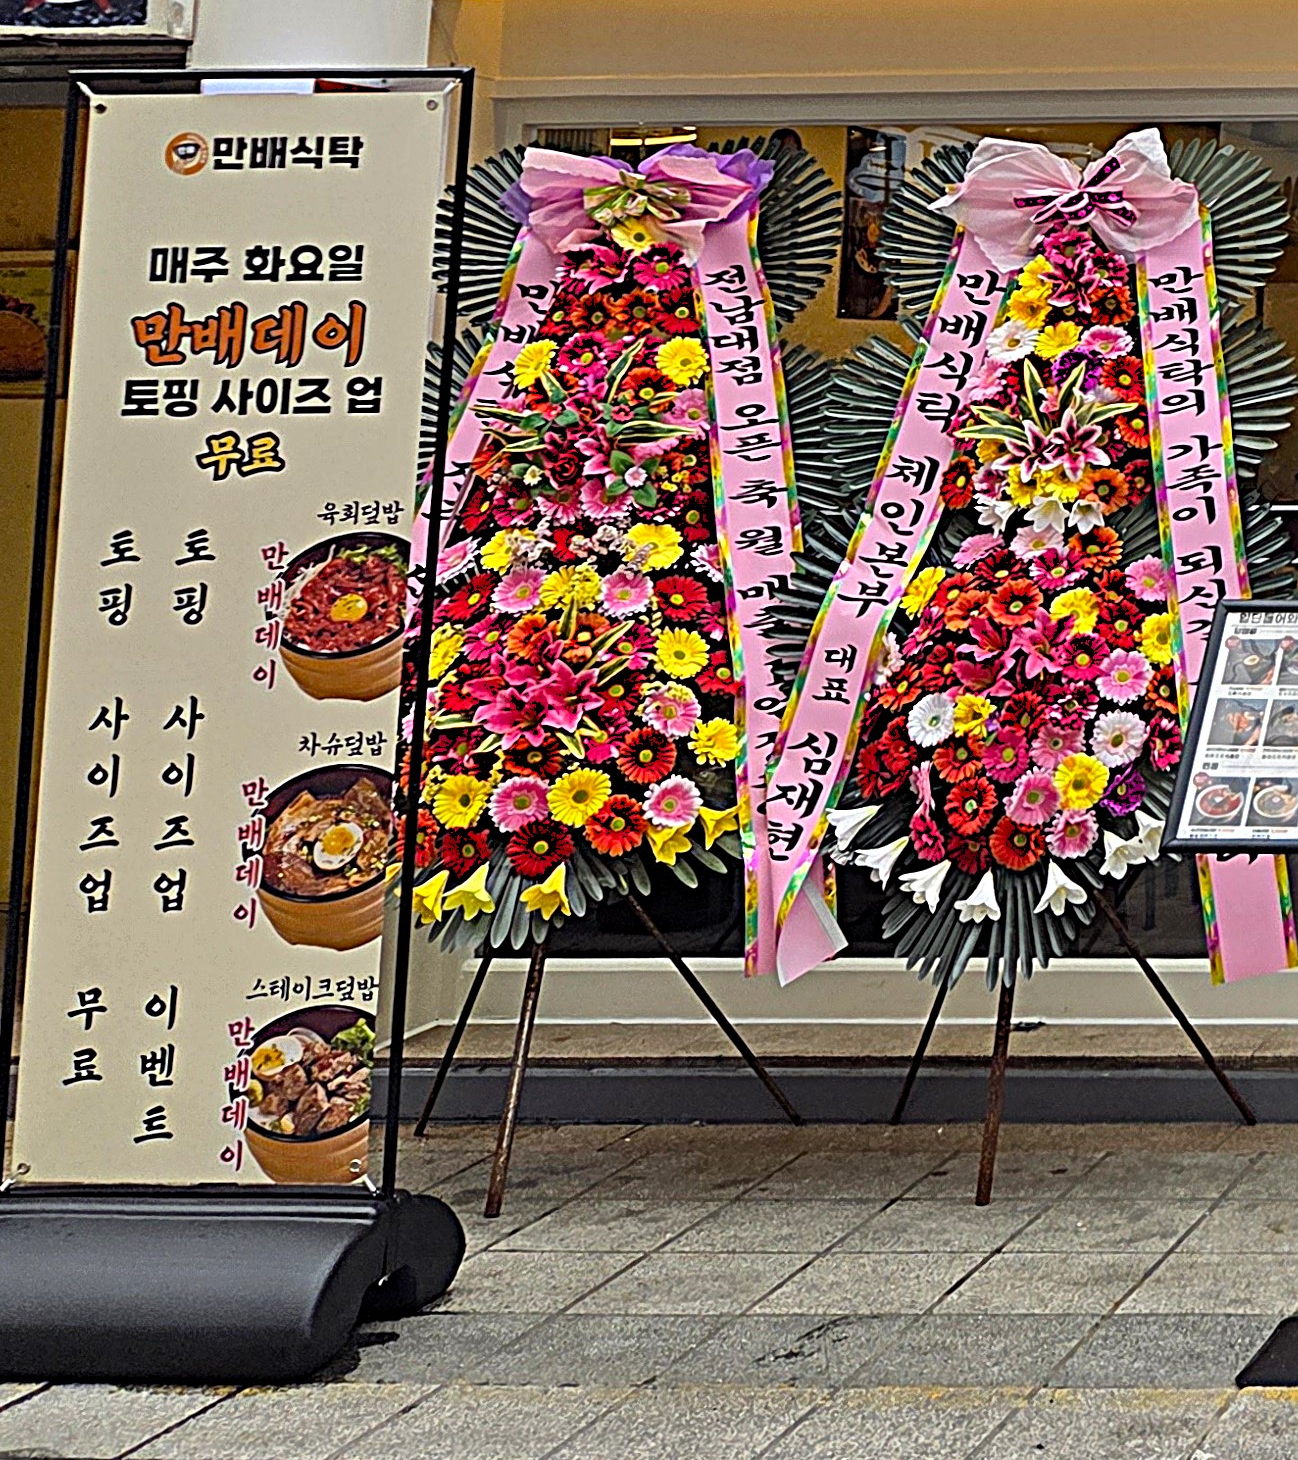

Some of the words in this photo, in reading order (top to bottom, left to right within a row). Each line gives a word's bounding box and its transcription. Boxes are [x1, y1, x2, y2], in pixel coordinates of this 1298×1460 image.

[212, 135, 364, 170] 만배식탁
[148, 246, 230, 283] 매주
[243, 245, 365, 282] 화요일
[130, 300, 369, 369] 만배데이
[703, 265, 765, 387] 전남대점
[917, 270, 1006, 434] 만배식탁
[1147, 266, 1214, 416] 만배식탁의
[121, 380, 199, 417] 토핑
[211, 378, 332, 416] 사이즈
[345, 376, 384, 414] 업
[720, 404, 781, 461] 오픈
[197, 431, 286, 480] 무료
[1166, 435, 1223, 526] 가족이
[316, 500, 405, 527] 육회덮밥
[98, 528, 141, 627] 토핑
[172, 527, 216, 626] 토핑
[251, 541, 288, 691] 만배데이
[813, 644, 858, 705] 대표
[297, 731, 388, 757] 차슈덮밥
[79, 696, 130, 914] 사이즈업
[153, 694, 206, 913] 사이즈업
[766, 731, 838, 862] 심재현
[232, 777, 269, 929] 만배데이
[62, 986, 108, 1087] 무료
[245, 975, 379, 1003] 스테이크덮밥
[133, 985, 180, 1145] 이벤트
[219, 1016, 254, 1171] 만배데이
